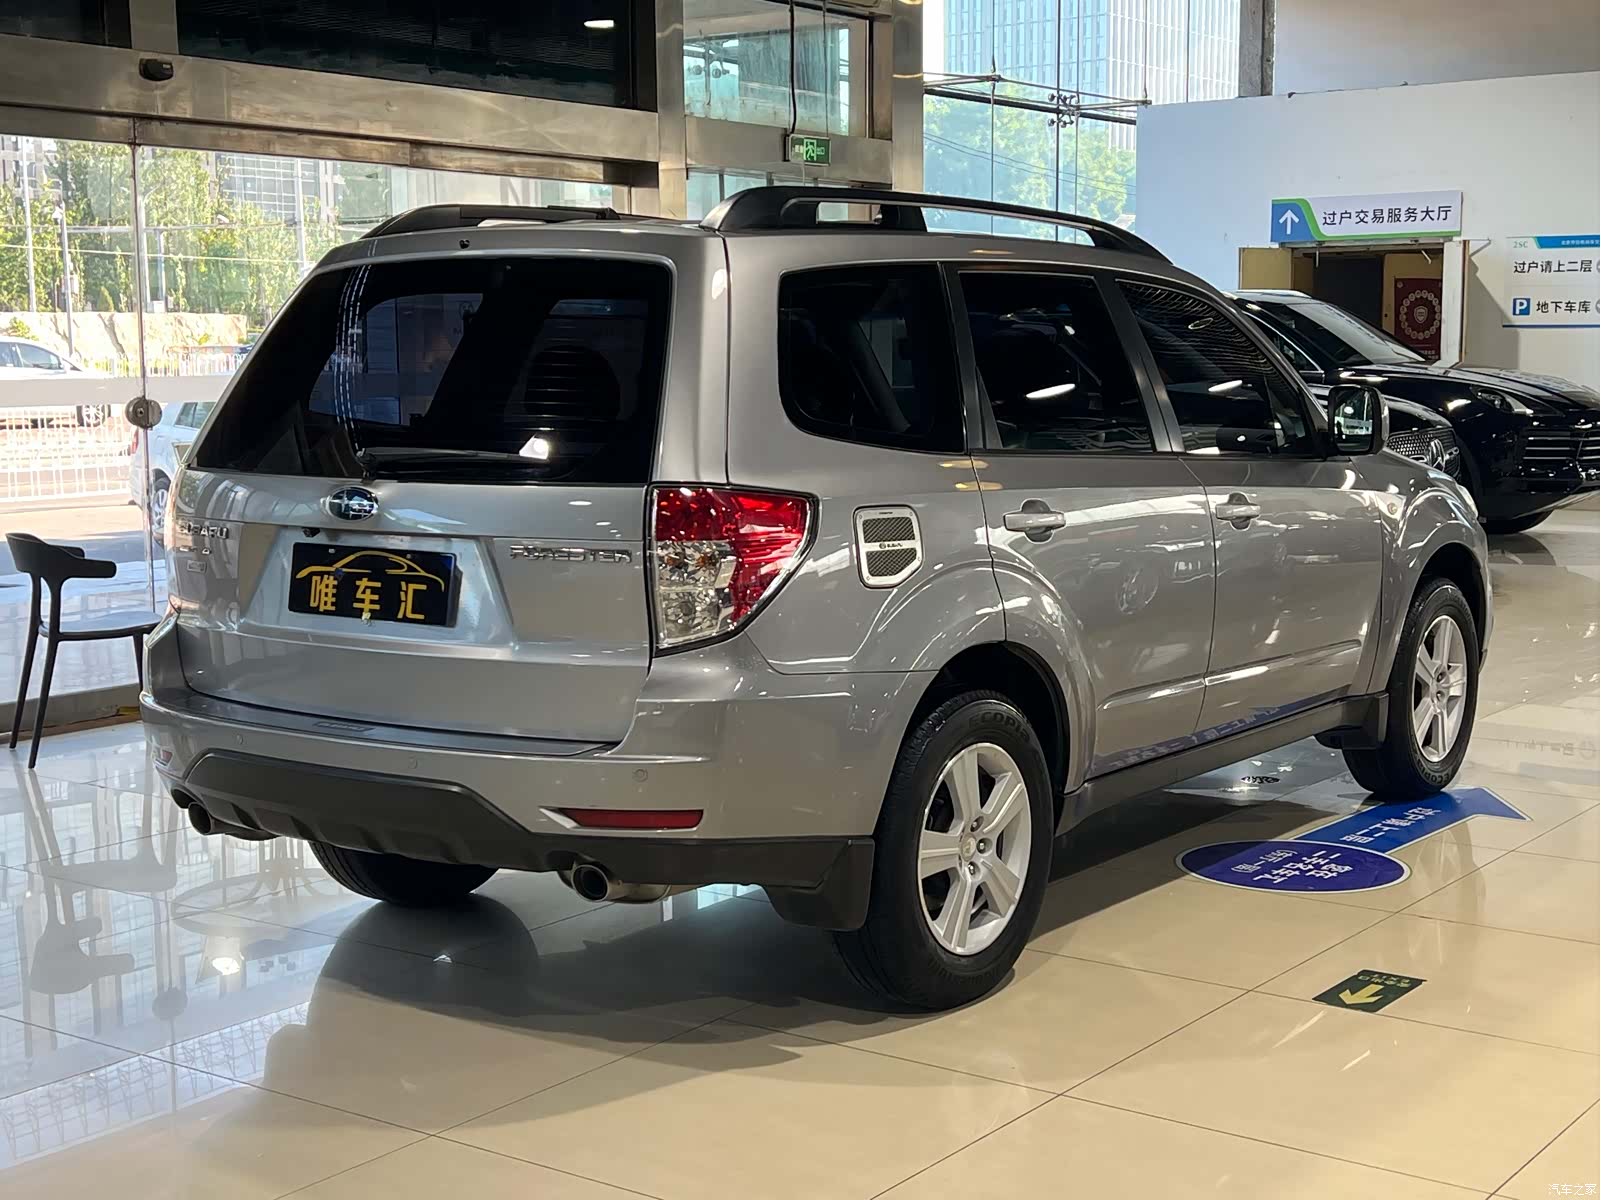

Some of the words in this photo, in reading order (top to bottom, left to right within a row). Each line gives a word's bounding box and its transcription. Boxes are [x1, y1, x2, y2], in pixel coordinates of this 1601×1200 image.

[1322, 205, 1453, 226] 过户交易服务大厅
[1513, 241, 1528, 249] 2SC
[1513, 260, 1593, 273] 过户请上二层
[1515, 299, 1528, 315] P
[1536, 300, 1591, 313] 地下车库
[510, 544, 633, 564] FORESTER
[309, 574, 428, 620] 唯车汇
[1339, 806, 1442, 844] 过户请上二层
[1252, 850, 1342, 884] 二手名车汇
